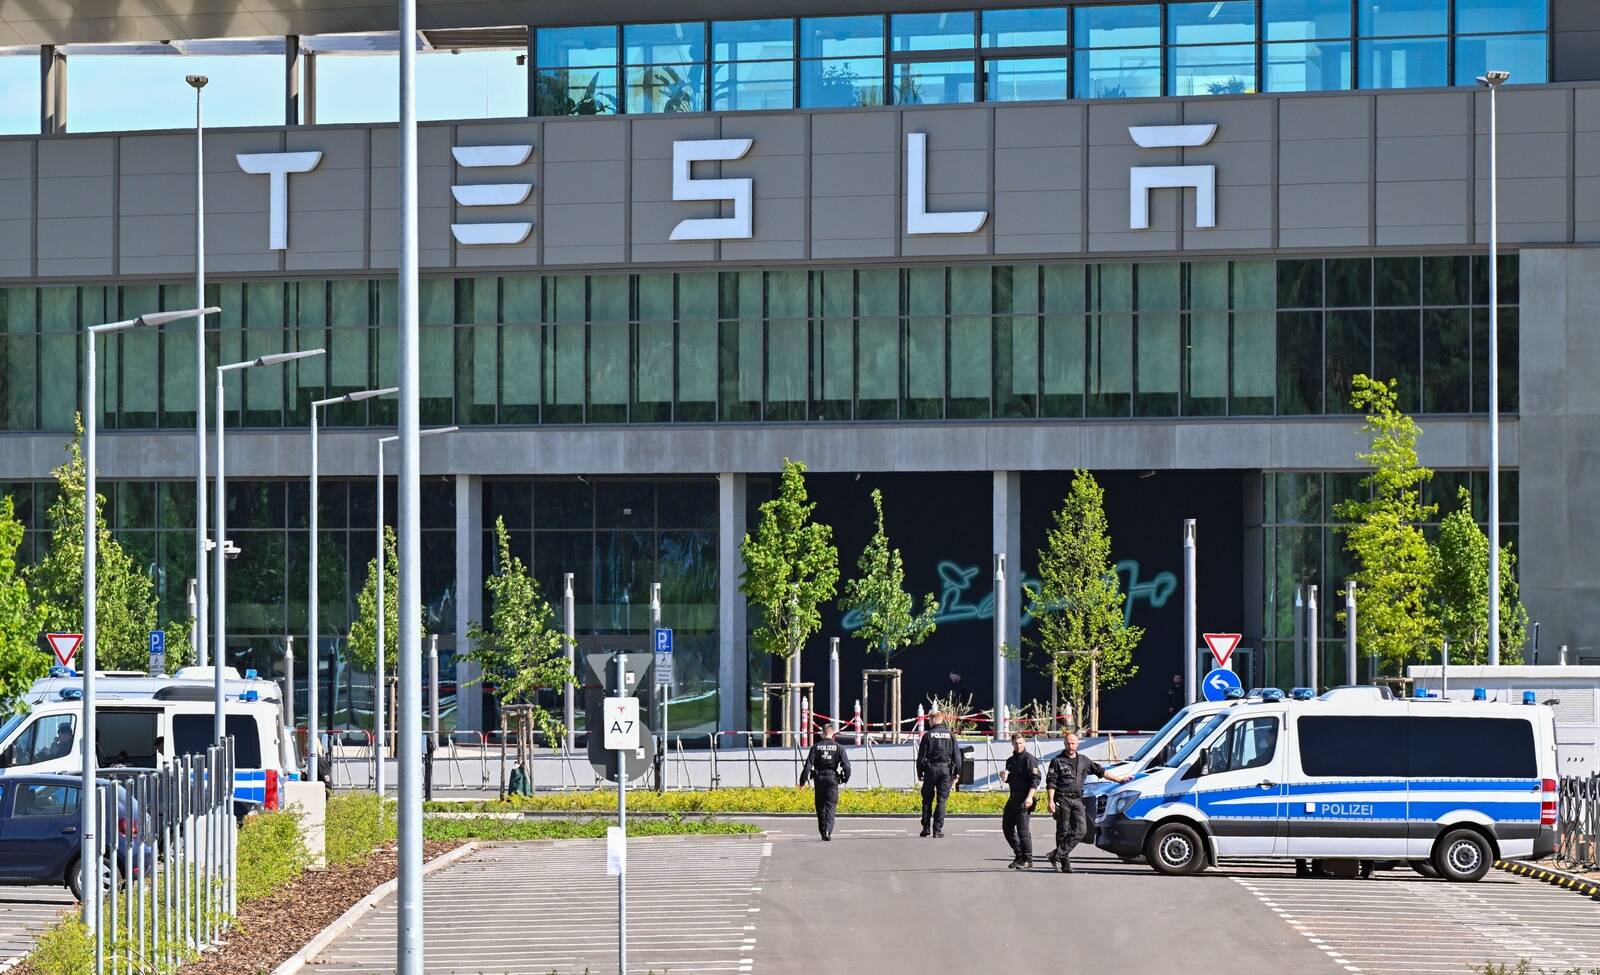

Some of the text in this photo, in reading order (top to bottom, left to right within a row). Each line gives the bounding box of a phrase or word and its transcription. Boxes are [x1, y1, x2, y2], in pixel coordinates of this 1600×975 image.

[236, 124, 1218, 250] TESLA
[151, 634, 160, 651] P
[657, 632, 668, 650] P
[610, 721, 634, 734] A7
[1321, 803, 1374, 816] POLIZEI
